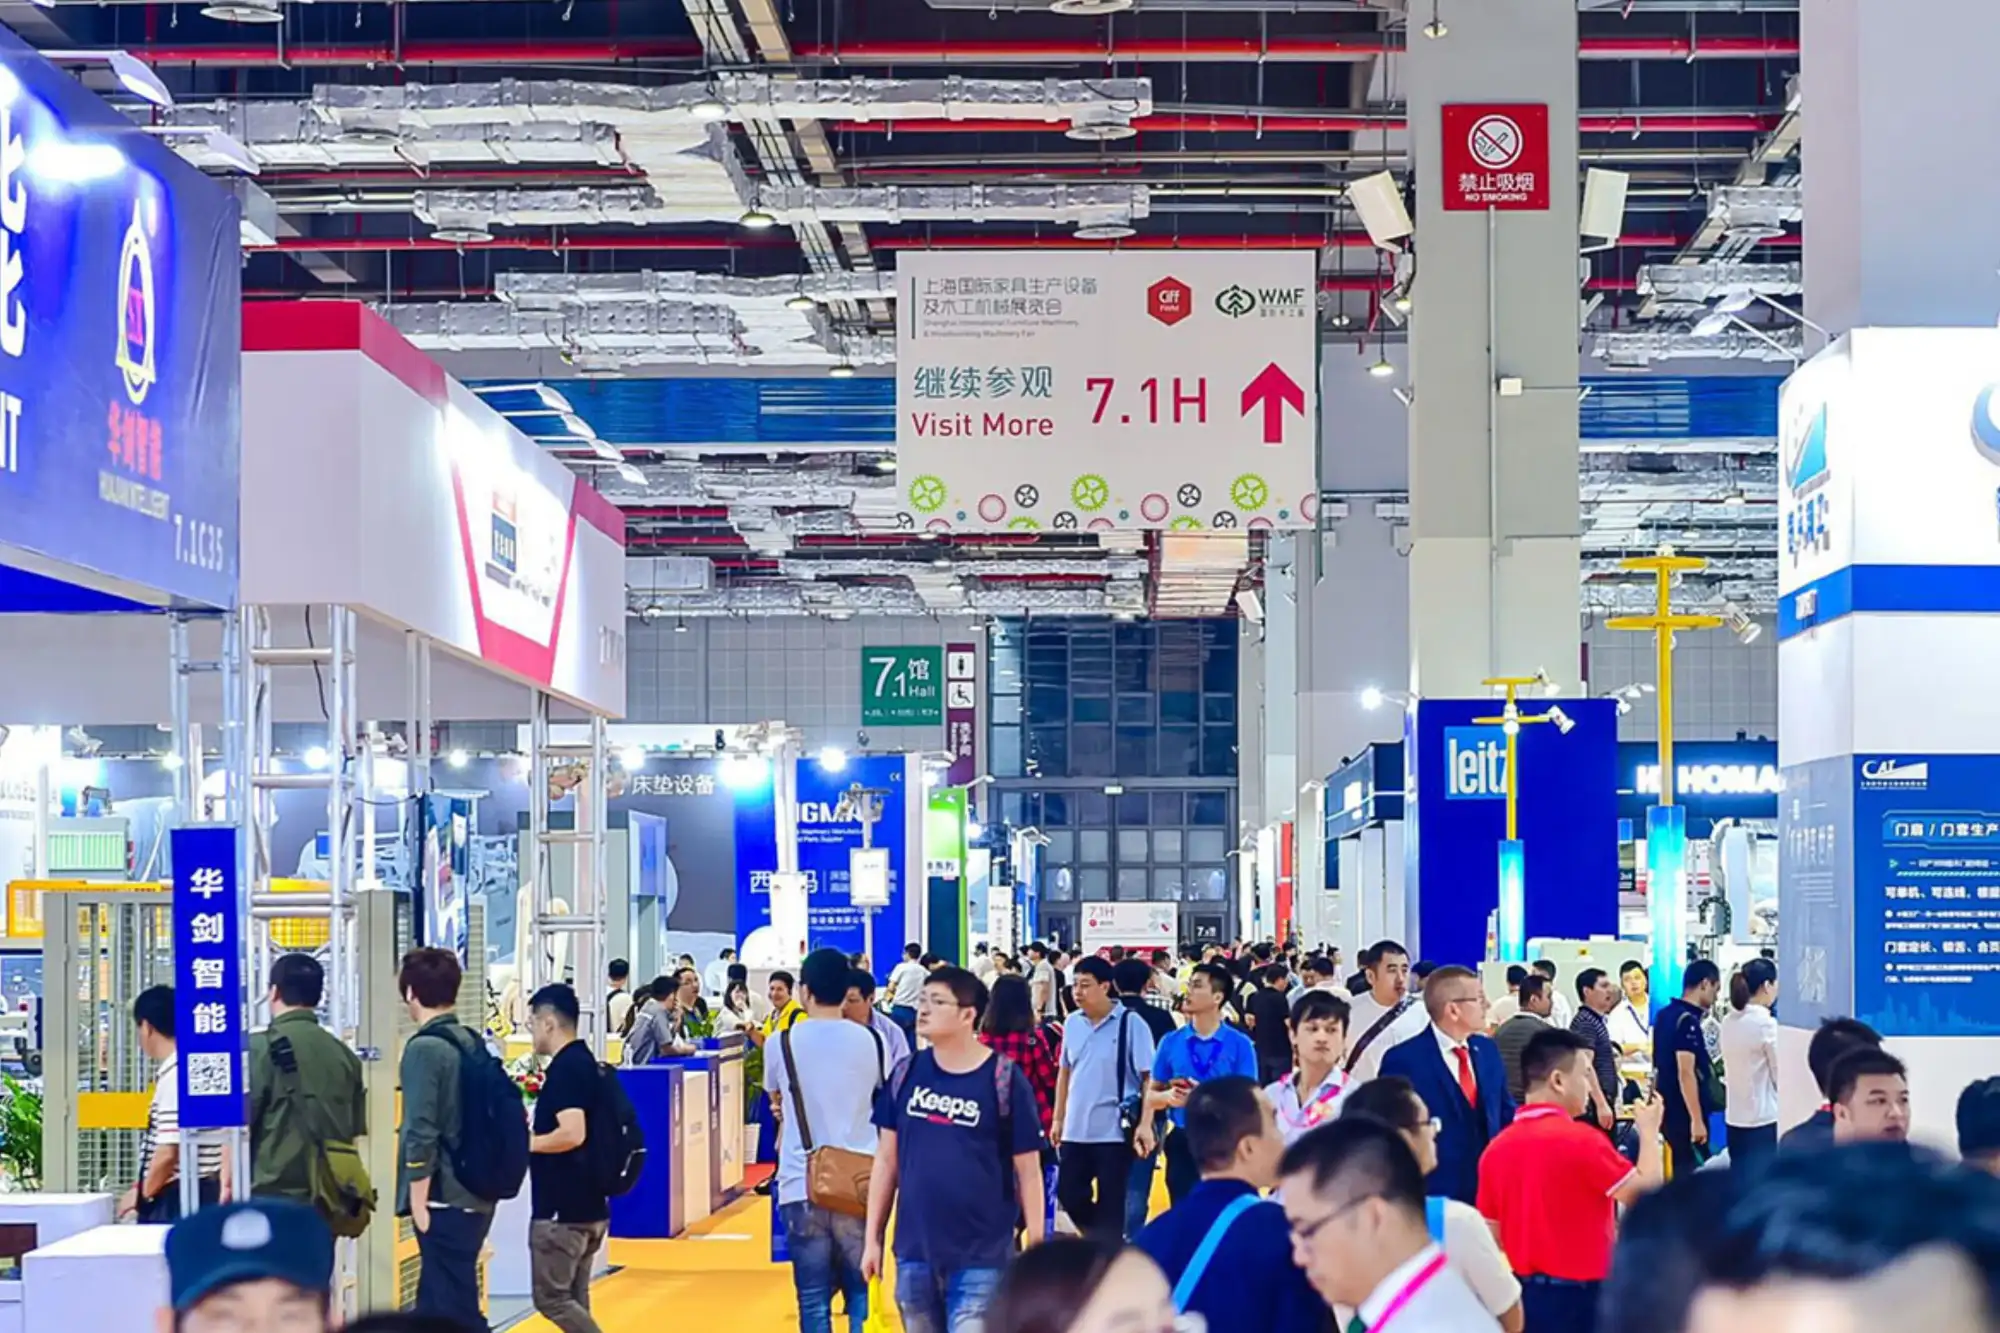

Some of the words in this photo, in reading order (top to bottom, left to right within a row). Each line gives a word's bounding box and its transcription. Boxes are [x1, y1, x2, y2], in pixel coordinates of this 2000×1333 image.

[1459, 172, 1534, 192] 禁止吸烟
[1465, 193, 1480, 202] NO
[1482, 193, 1528, 202] SMOKING
[923, 276, 1098, 296] 上海国际家具生产设备
[1258, 288, 1305, 305] WMF
[923, 298, 1063, 316] 及木工机械展览会
[914, 366, 1053, 399] 继续参观
[1086, 377, 1206, 424] 7.1H
[912, 412, 973, 437] Visit
[983, 412, 1054, 437] More
[173, 514, 224, 572] 7.1C35
[869, 656, 906, 697] 7.1
[908, 658, 929, 680] 馆
[909, 685, 935, 697] Hall
[632, 774, 715, 796] 床垫设备
[190, 868, 227, 1033] 华剑智能
[911, 1085, 979, 1118] Keeps
